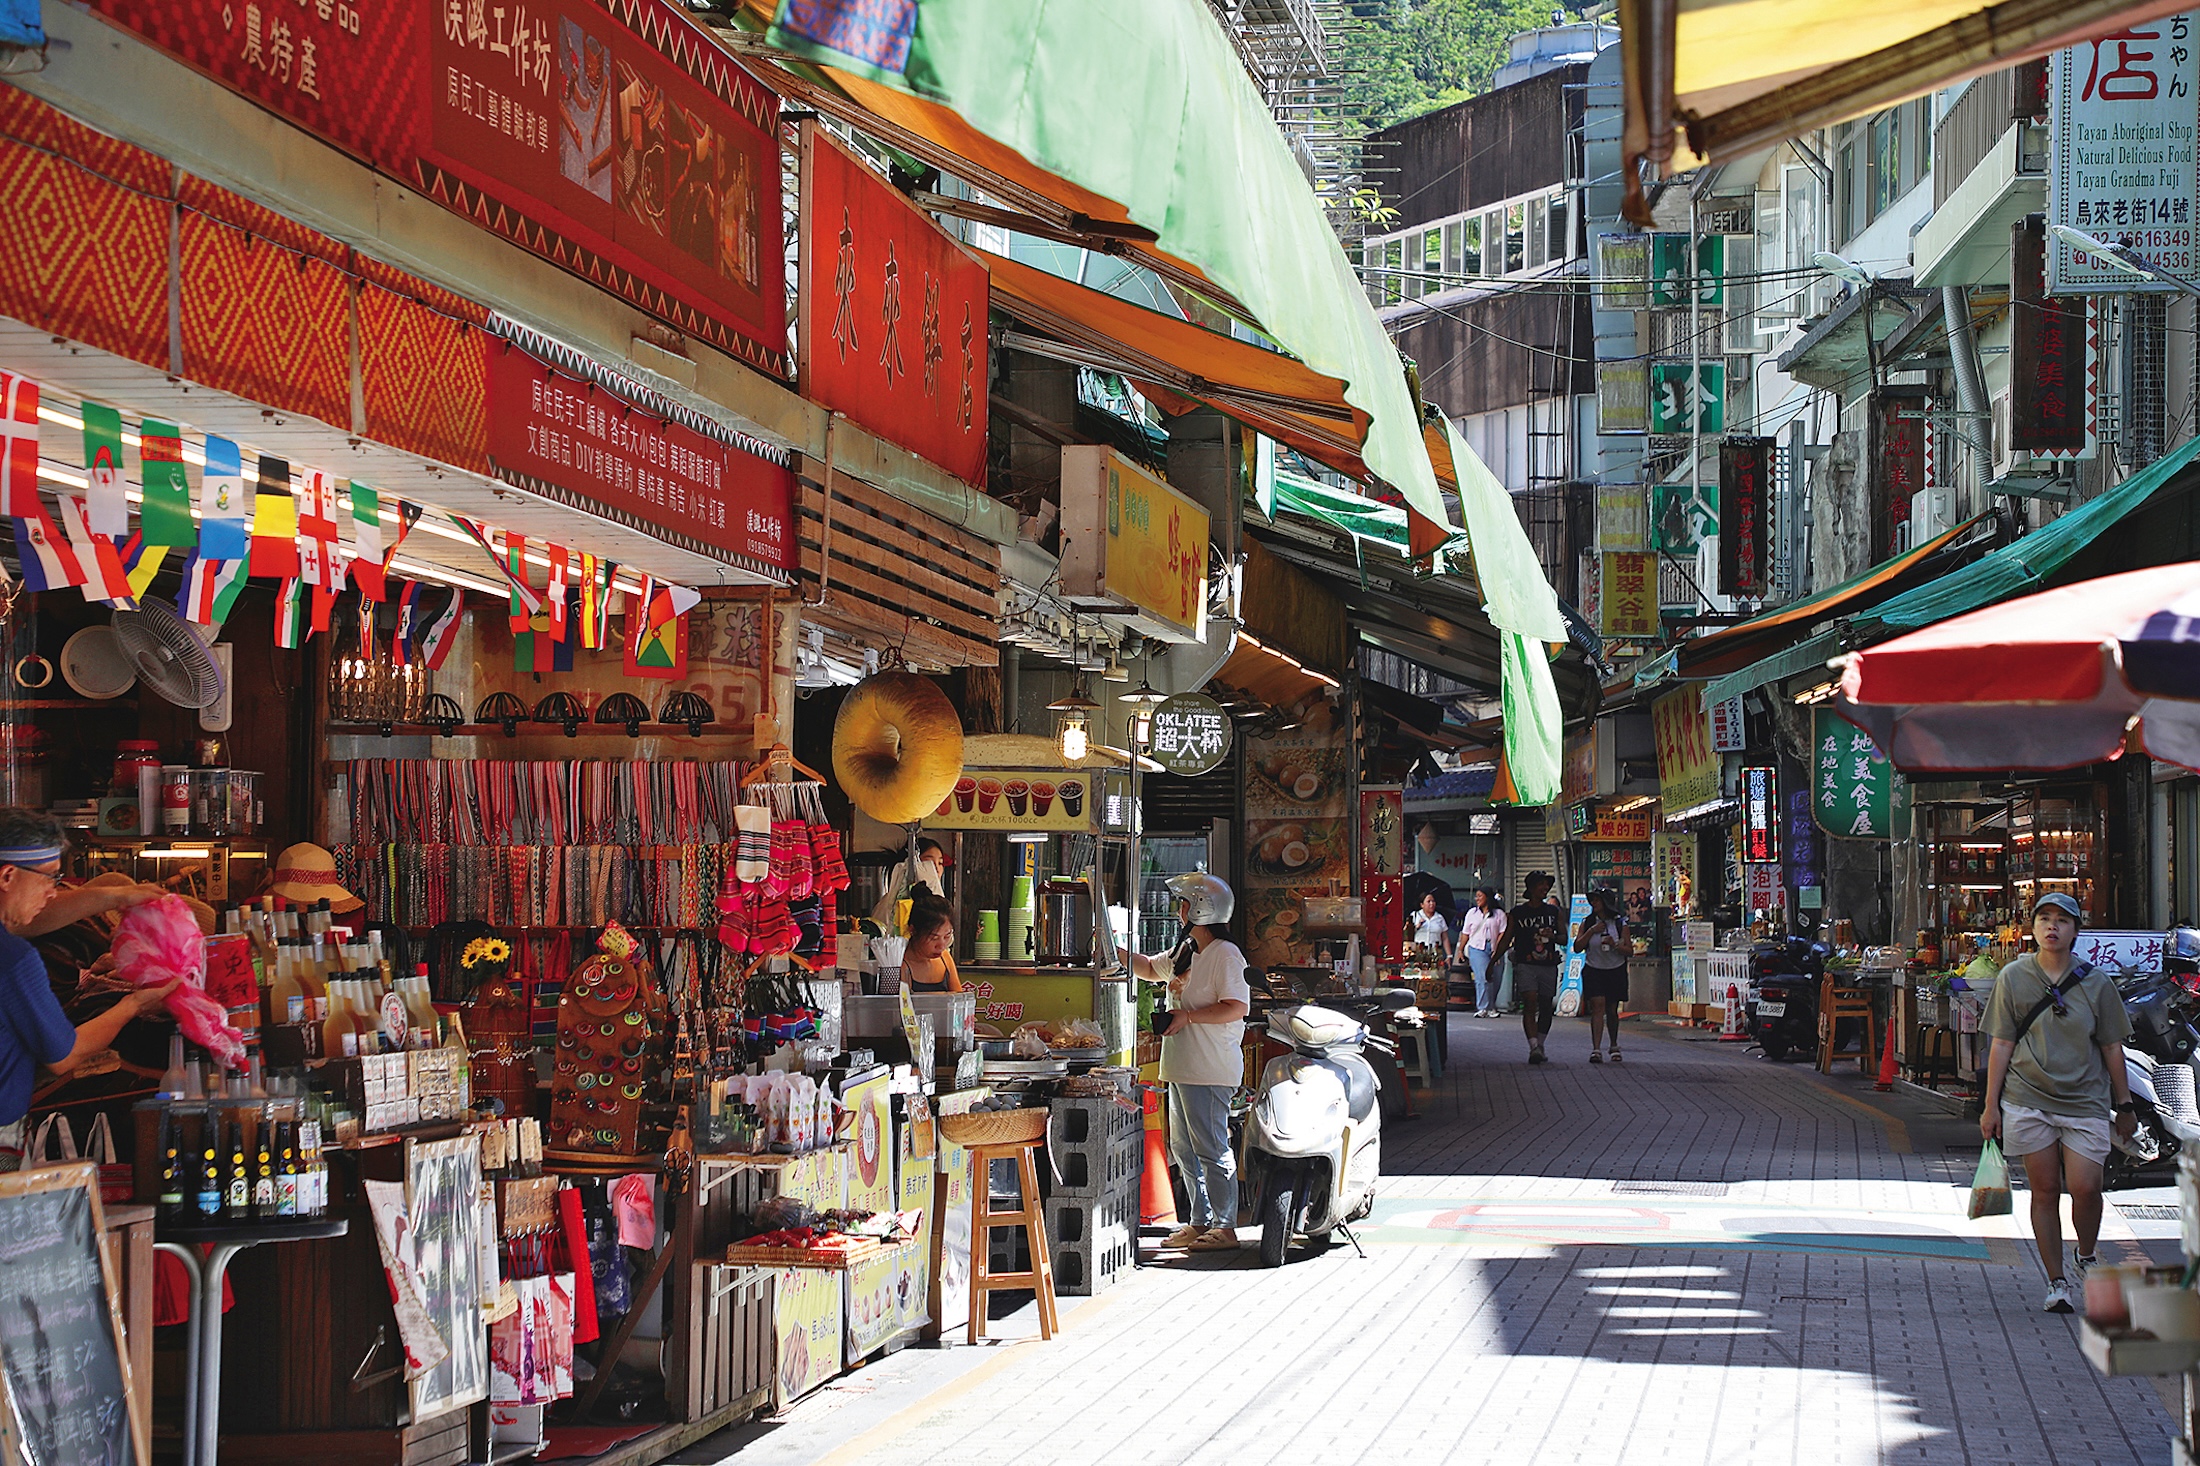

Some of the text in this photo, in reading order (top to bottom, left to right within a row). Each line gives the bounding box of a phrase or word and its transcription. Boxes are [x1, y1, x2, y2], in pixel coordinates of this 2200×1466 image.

[313, 0, 360, 36] 品
[241, 4, 320, 100] 農特產
[2077, 121, 2193, 144] Tayan Aboriginal Shop
[2077, 145, 2191, 165] Natural Delicious Food
[2077, 168, 2179, 191] Tayan Grandma Fuji
[2076, 197, 2189, 226] 烏來老街14號
[532, 379, 721, 490] 原住民手工編織 各式大小包包 舞蹈服飾訂做
[527, 421, 571, 467] 文創商品
[638, 466, 664, 506] 農特產
[668, 480, 685, 514] 馬告
[689, 489, 706, 521] 小米
[1616, 554, 1645, 617] 翡翠谷
[1155, 712, 1221, 728] OKLATEE
[1728, 696, 1741, 747] 6616198
[1154, 726, 1223, 760] 超大杯
[1168, 760, 1206, 769] 紅茶專賣
[1821, 735, 1839, 808] 在地美食
[1849, 726, 1876, 836] 地美食屋
[1750, 770, 1767, 859] 旅遊團體訂餐
[1752, 870, 1771, 910] 泡腳
[1518, 916, 1555, 928] VOGUE
[2070, 938, 2163, 971] 板烤
